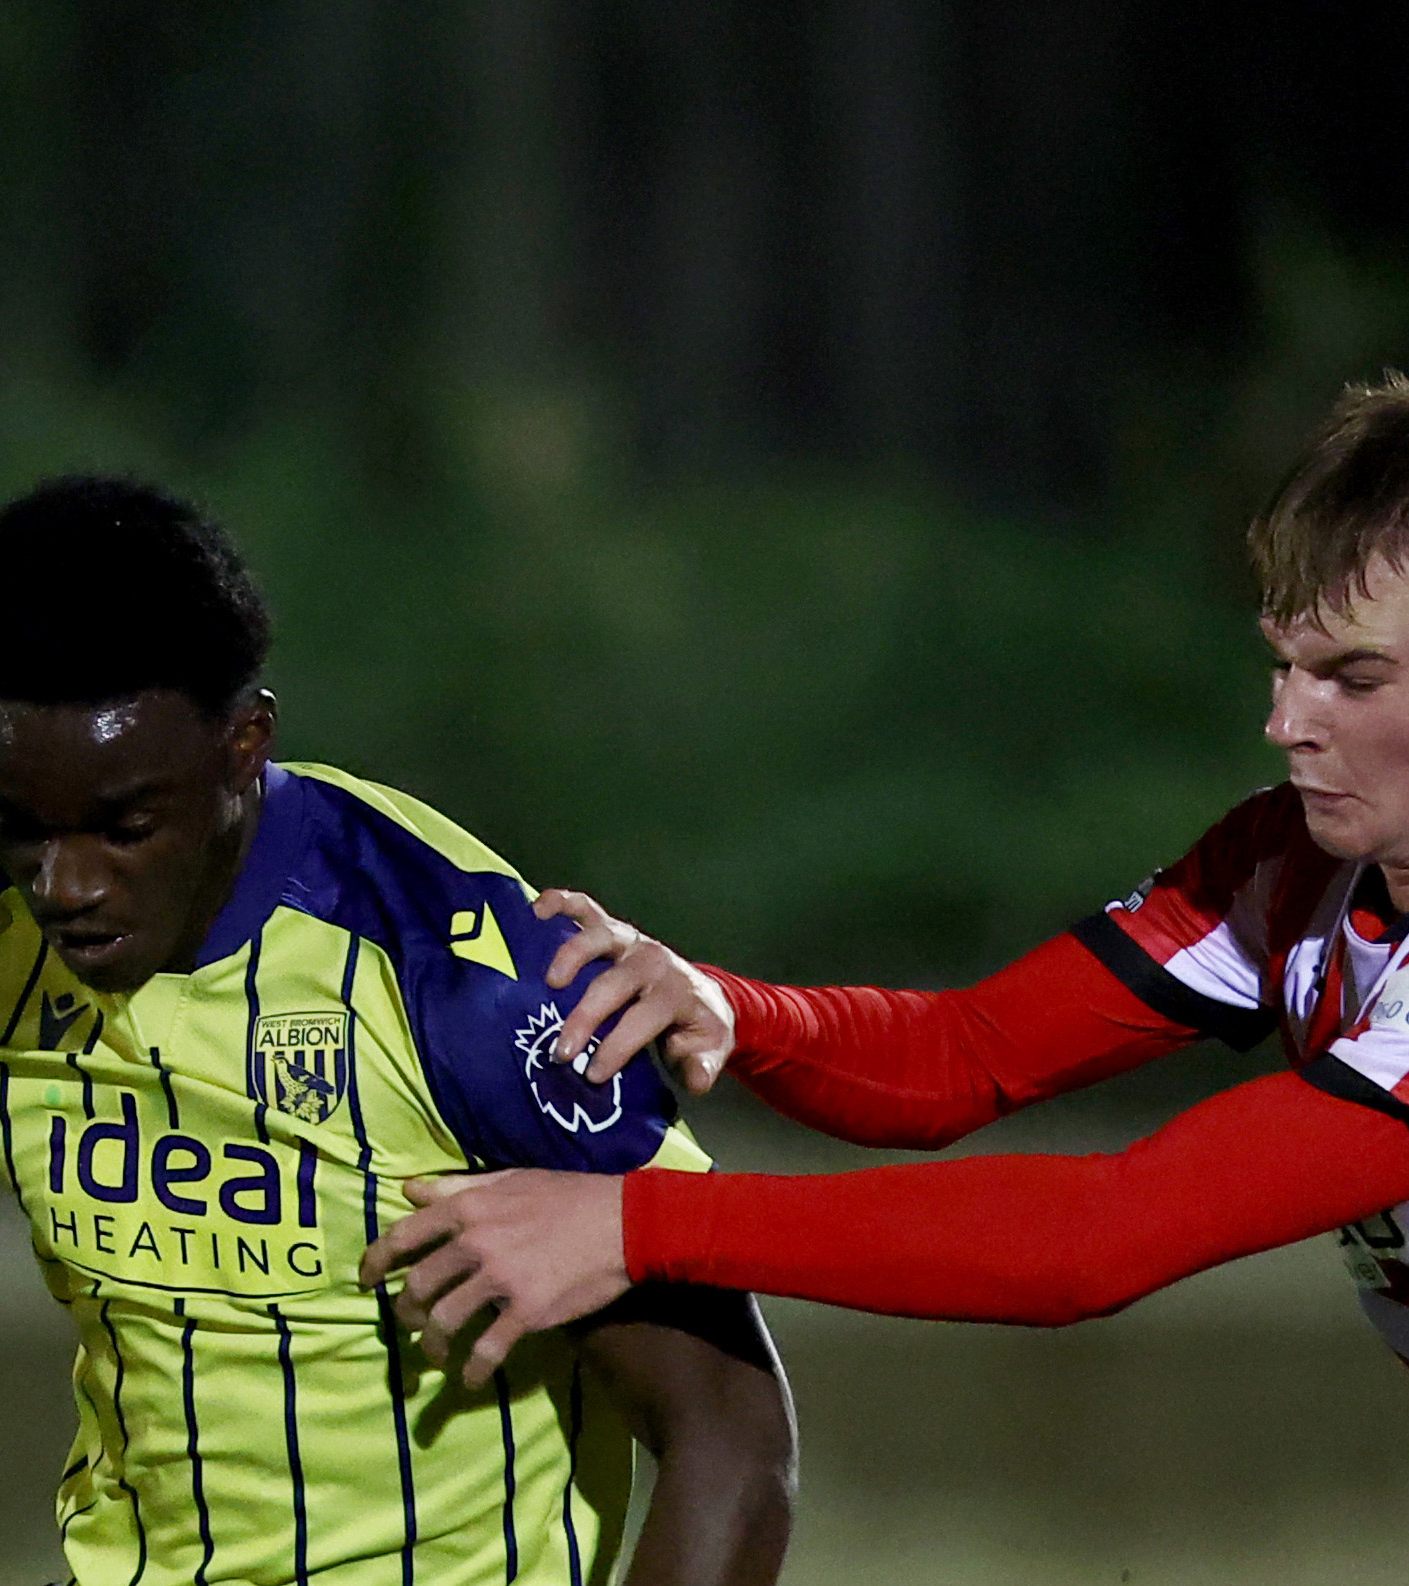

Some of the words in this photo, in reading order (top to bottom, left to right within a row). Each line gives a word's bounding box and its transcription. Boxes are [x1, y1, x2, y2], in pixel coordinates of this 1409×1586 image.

[259, 1026, 339, 1047] ALBION
[261, 1019, 288, 1028] WEST
[46, 1084, 318, 1228] ideal
[50, 1206, 323, 1277] HEATING
